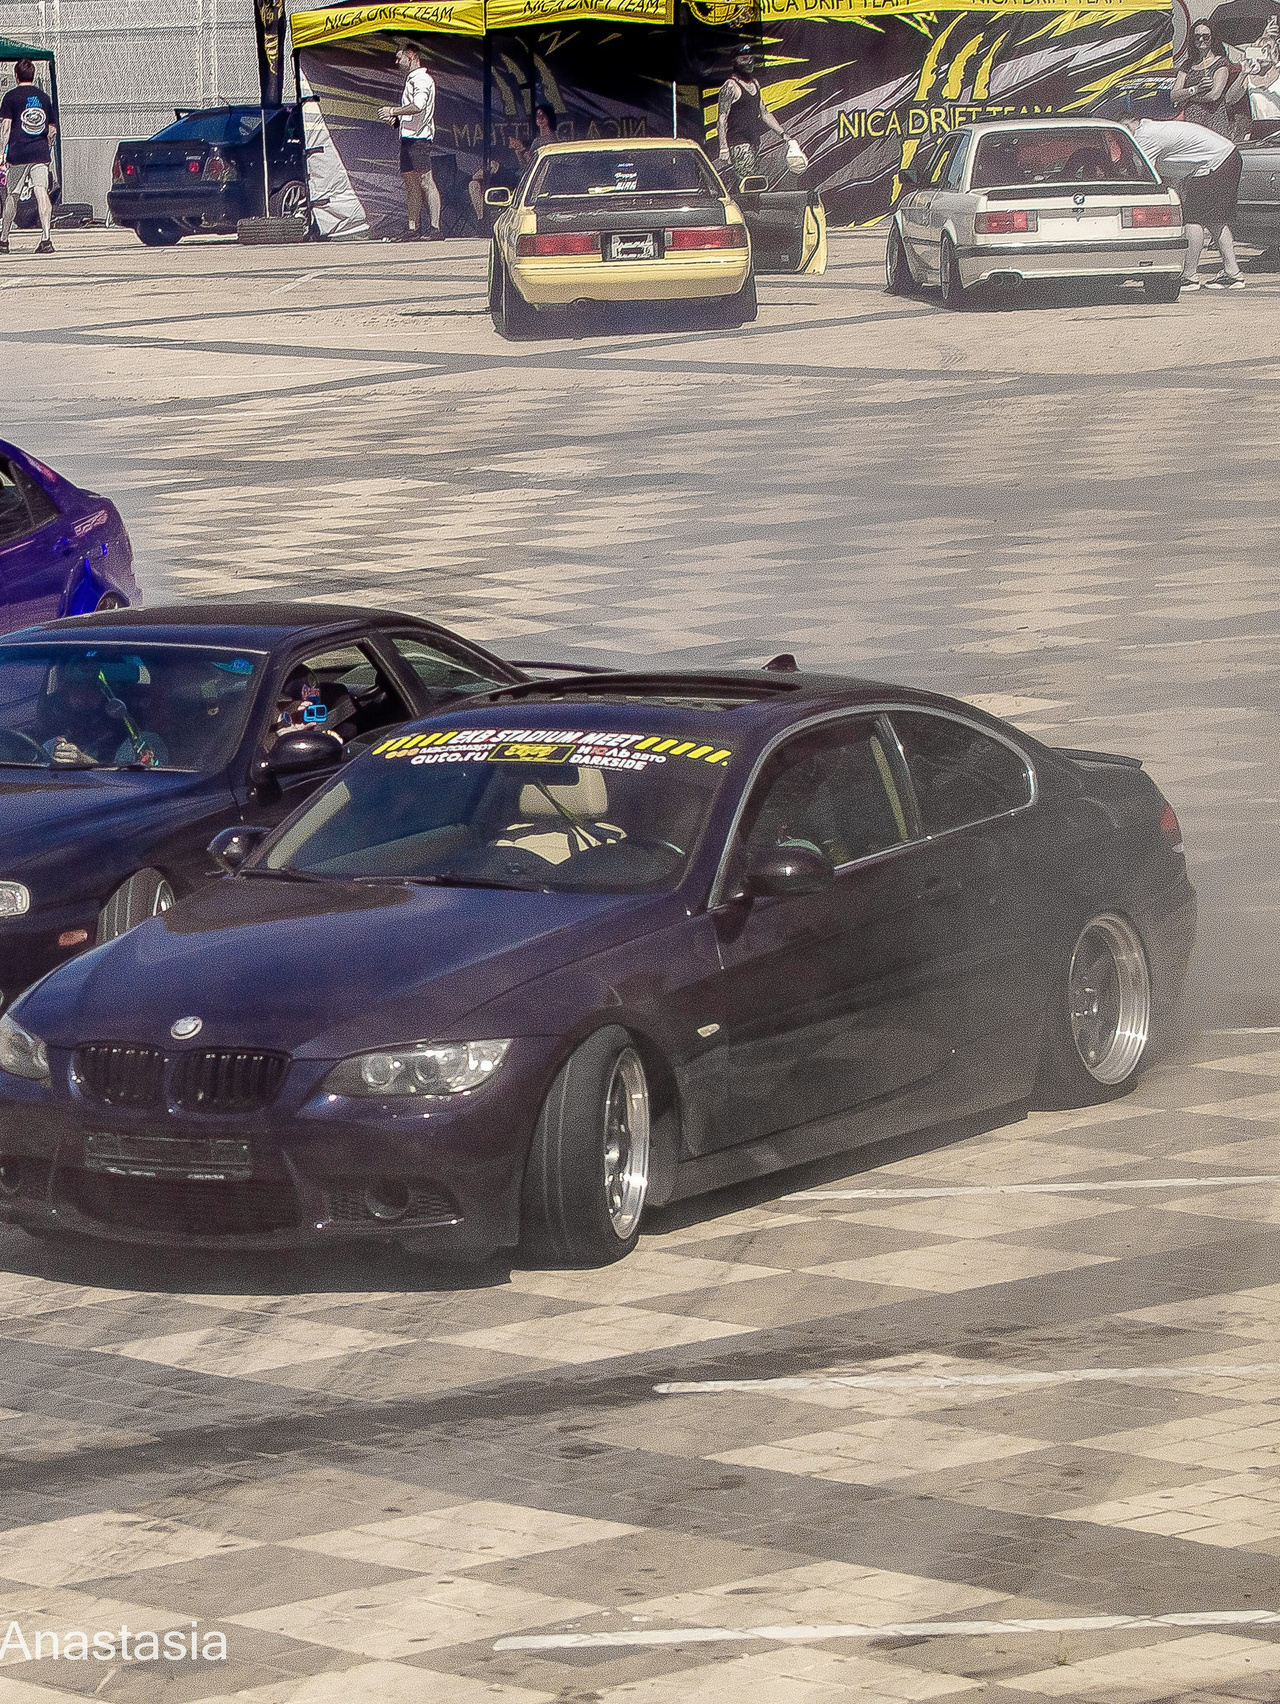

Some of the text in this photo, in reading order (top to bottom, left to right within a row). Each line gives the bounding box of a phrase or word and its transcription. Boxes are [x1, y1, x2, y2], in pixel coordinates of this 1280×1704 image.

[323, 12, 363, 31] NICA
[413, 6, 455, 22] TEAM
[839, 110, 902, 138] NICA
[490, 729, 583, 744] STADIUM
[577, 732, 645, 747] MEET
[410, 750, 489, 766] auto.ru
[568, 754, 648, 771] DARKSIDE
